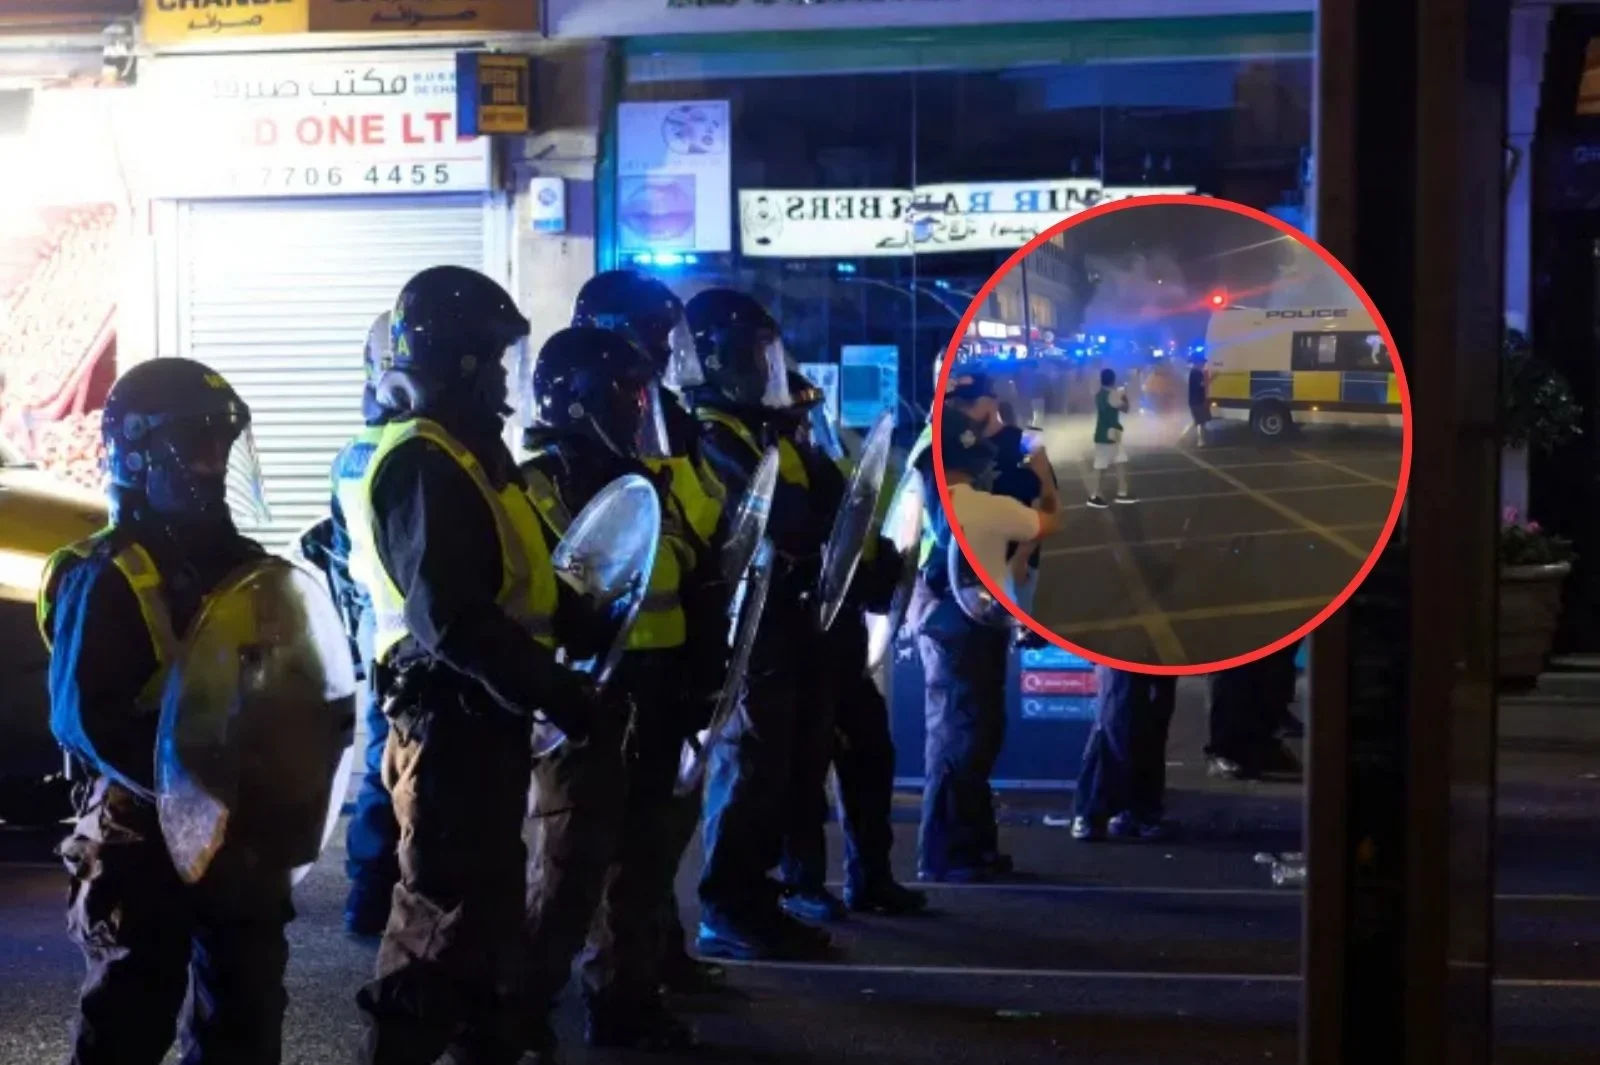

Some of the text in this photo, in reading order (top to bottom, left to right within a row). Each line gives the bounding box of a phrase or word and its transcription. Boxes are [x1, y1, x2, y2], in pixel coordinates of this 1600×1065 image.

[309, 68, 407, 106] مكتب
[296, 113, 385, 146] ONE
[402, 112, 479, 144] LT
[261, 166, 343, 187] 7706
[364, 163, 450, 185] 4455
[1266, 308, 1348, 319] POLICE
